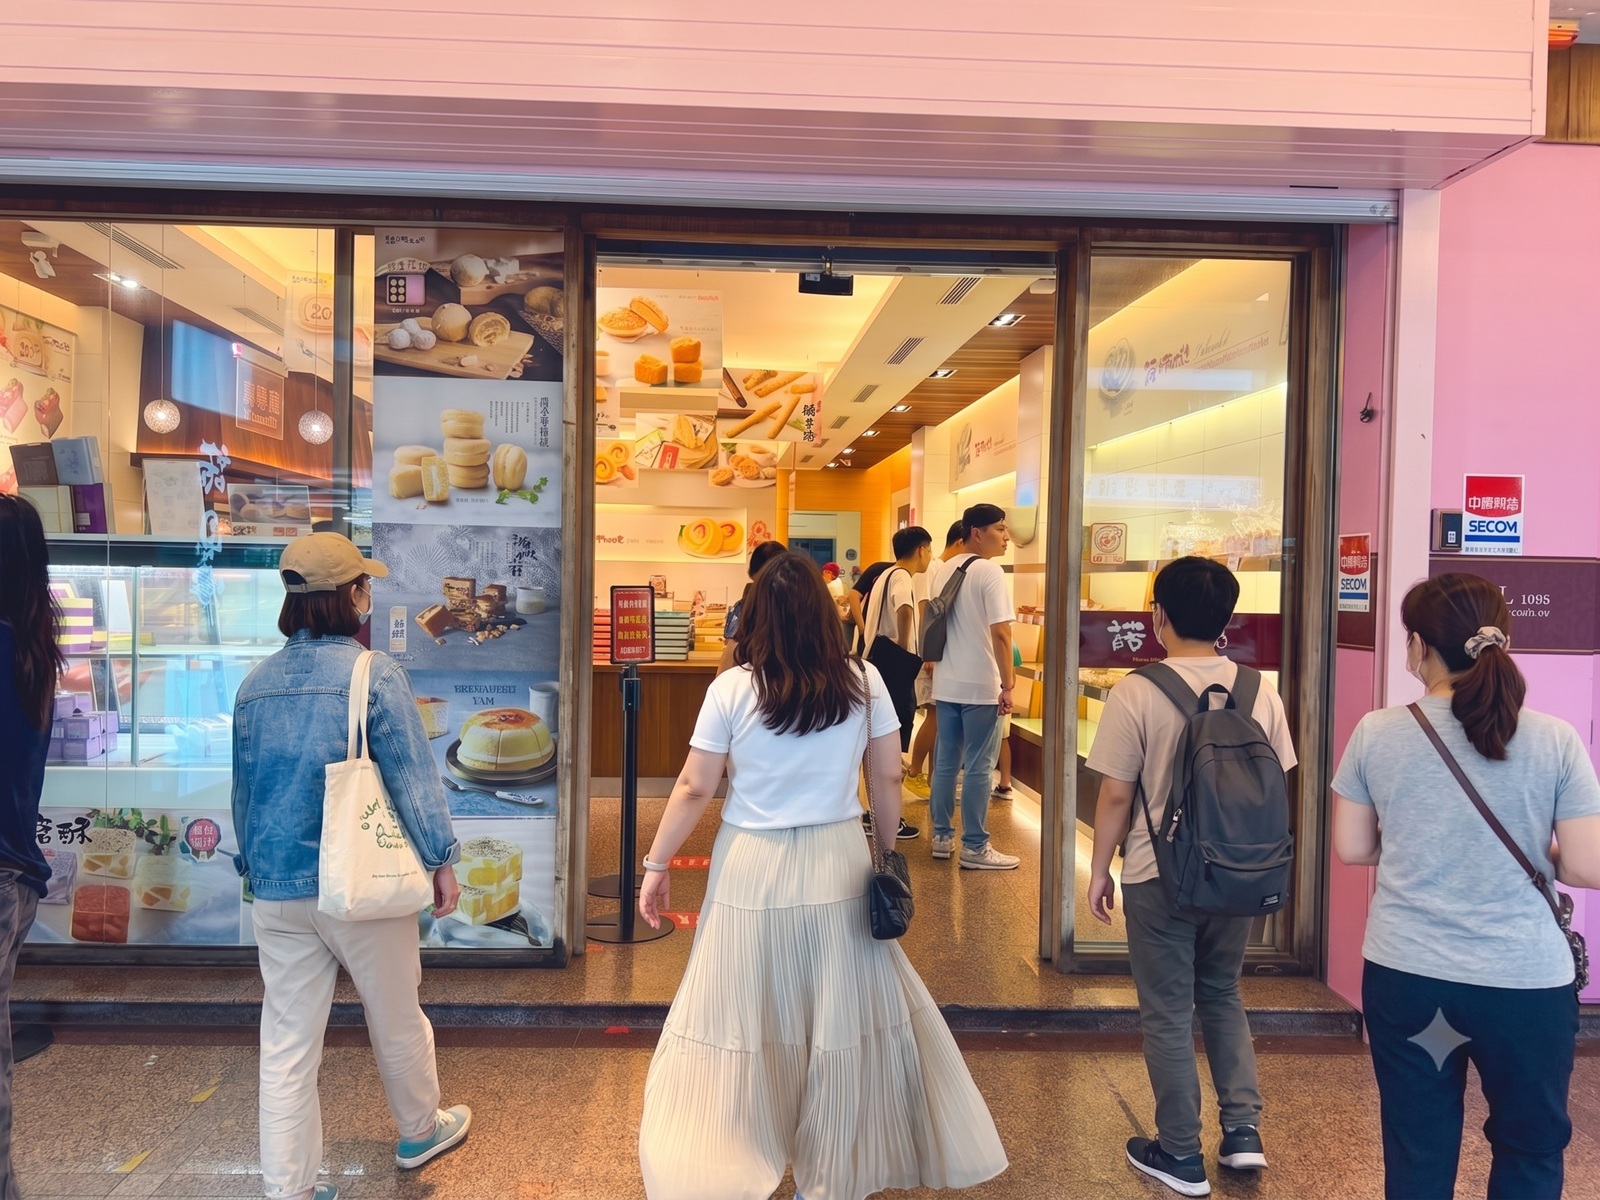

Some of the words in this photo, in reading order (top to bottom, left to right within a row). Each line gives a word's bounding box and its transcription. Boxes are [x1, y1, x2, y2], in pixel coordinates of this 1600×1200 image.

[1469, 520, 1518, 533] SECOM
[1341, 578, 1367, 591] SECOM
[472, 696, 495, 706] YAM
